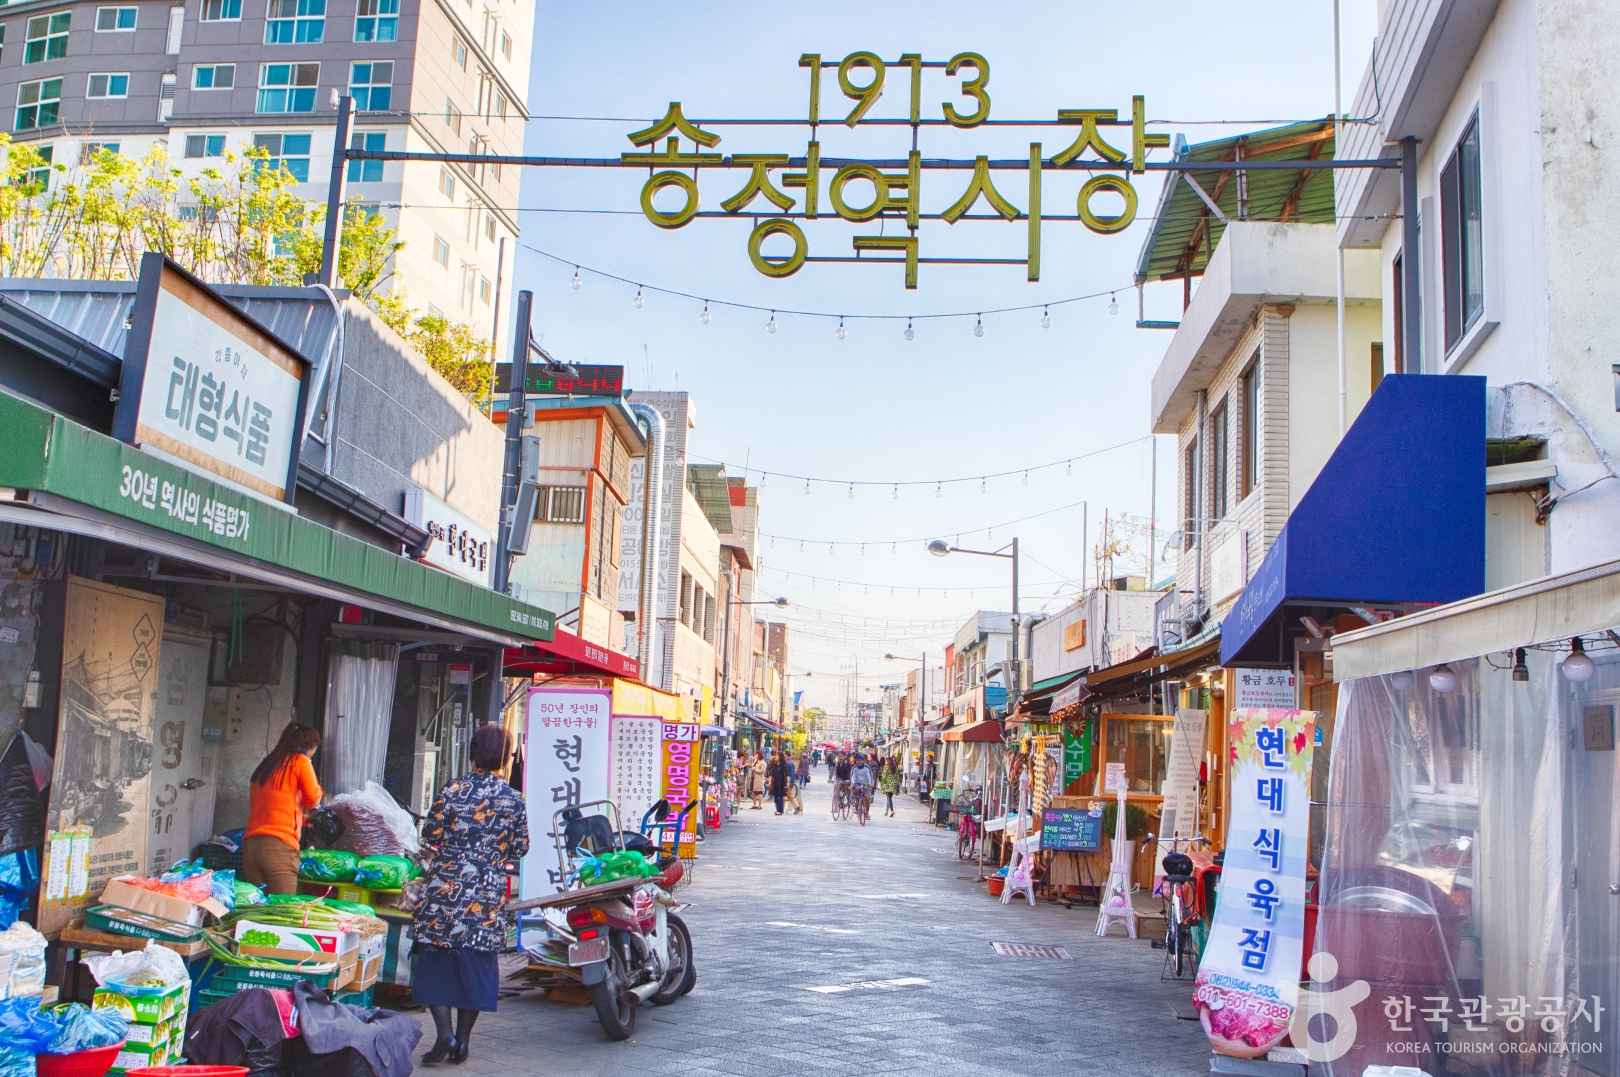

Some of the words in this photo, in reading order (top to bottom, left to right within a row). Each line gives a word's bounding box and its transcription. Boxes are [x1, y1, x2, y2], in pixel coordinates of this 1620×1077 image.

[800, 51, 991, 128] 1913
[621, 95, 1170, 289] 송정역시장
[165, 356, 272, 466] 대형식품
[120, 465, 158, 509] 30년
[161, 482, 200, 525] 역사의
[203, 498, 250, 540] 식품명가
[540, 704, 564, 713] 50년
[664, 725, 696, 740] 명가
[1237, 727, 1284, 970] 현대식육점
